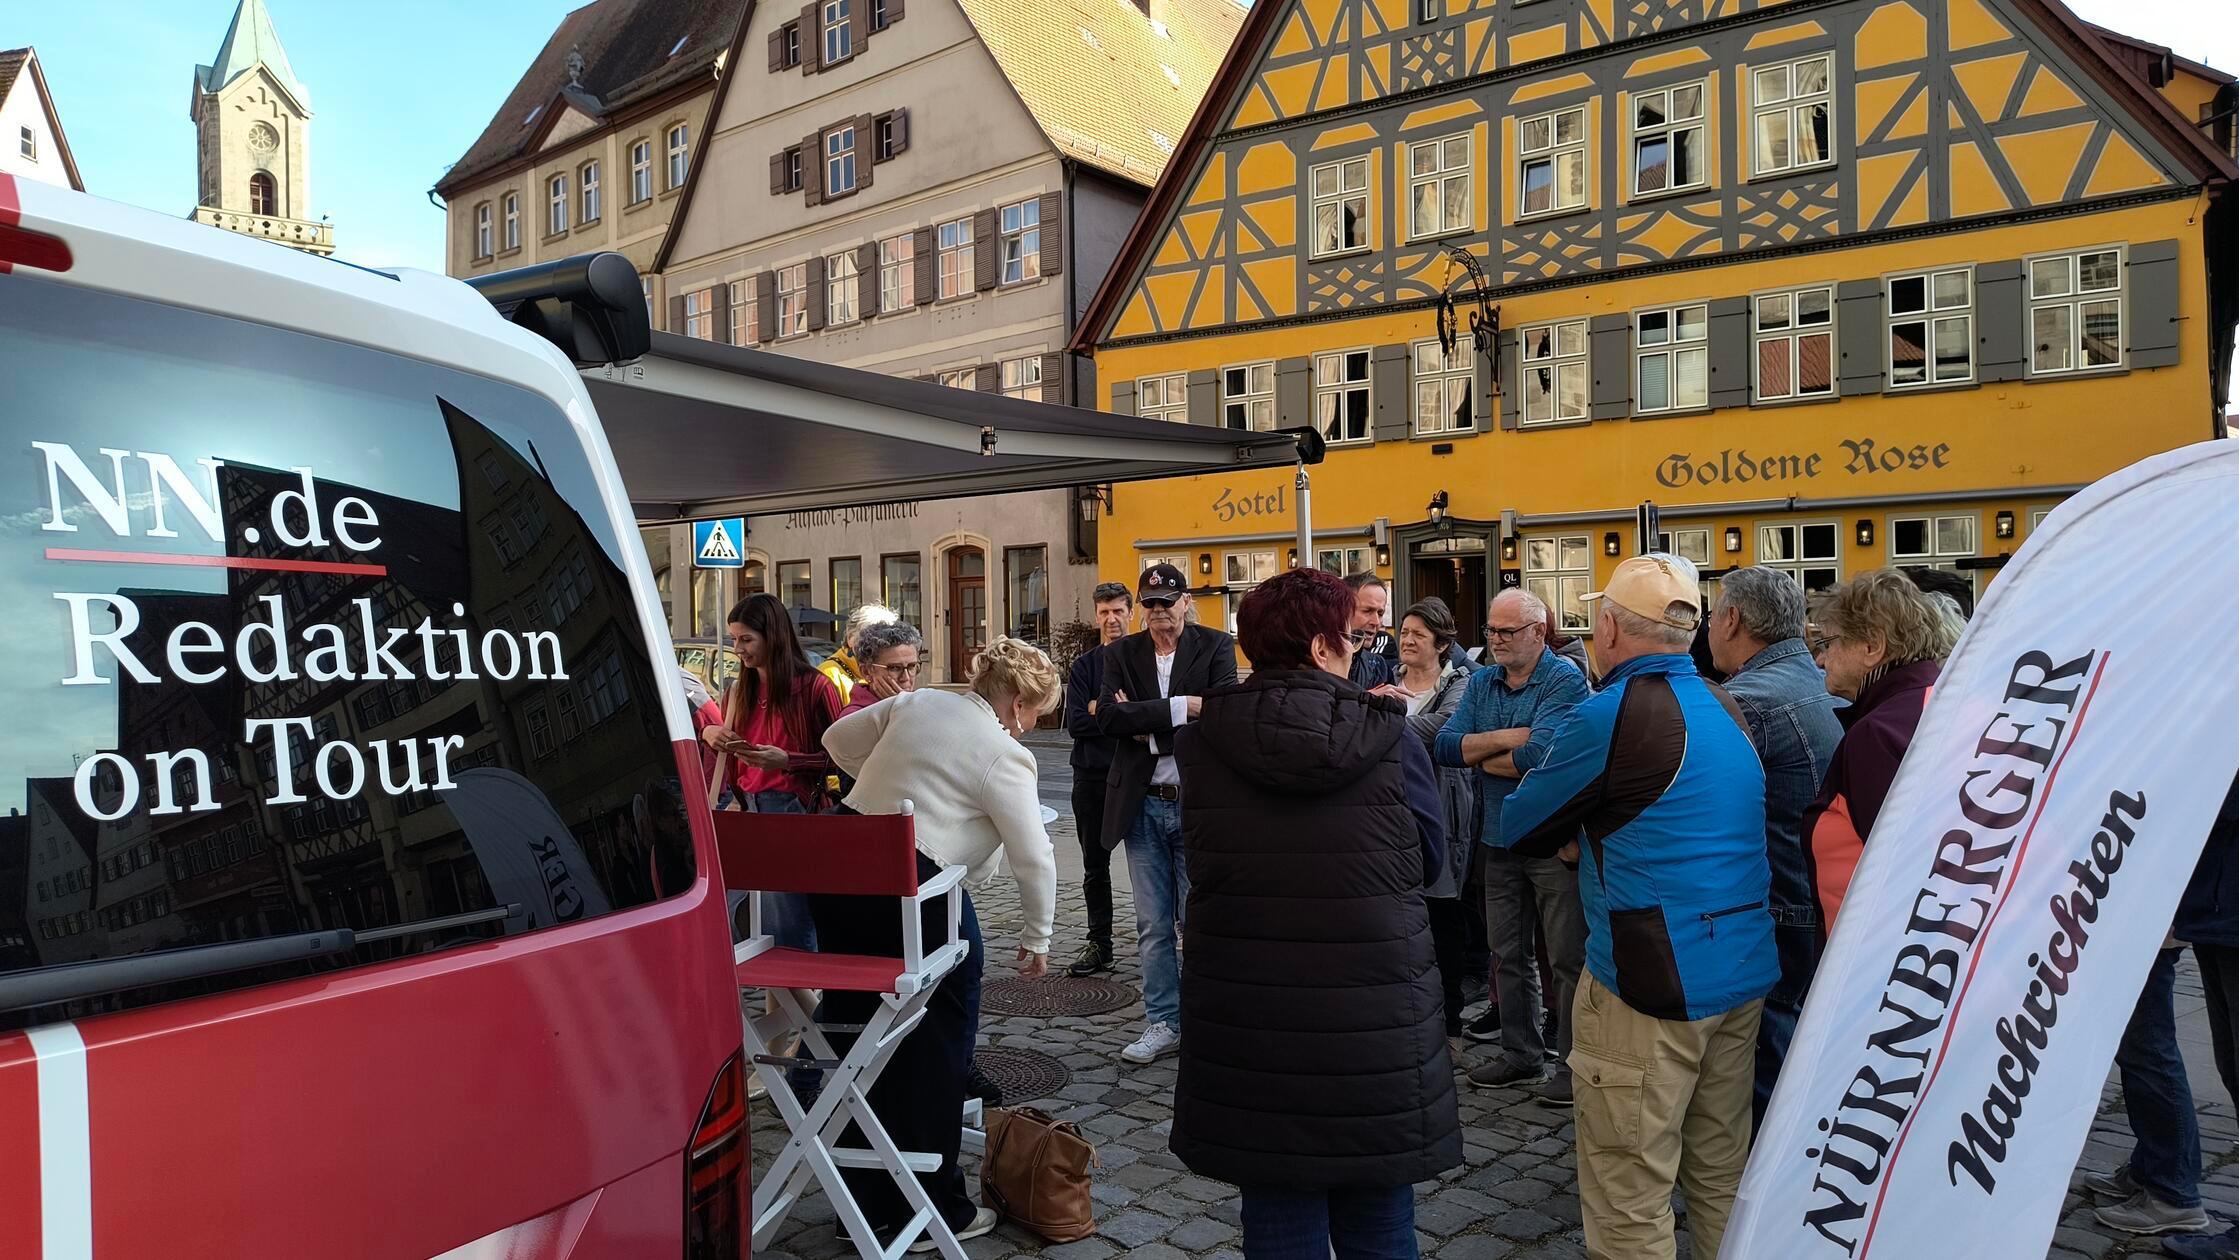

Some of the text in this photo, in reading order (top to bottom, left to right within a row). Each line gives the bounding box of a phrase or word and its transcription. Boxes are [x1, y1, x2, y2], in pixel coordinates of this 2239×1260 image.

[32, 441, 382, 551] NN.de
[1211, 483, 1287, 522] Hotel
[1655, 437, 1951, 489] Goldene Rose
[1503, 573, 1517, 584] QL
[53, 592, 570, 686] Redaktion
[73, 716, 465, 820] on Tour
[1803, 649, 2096, 1258] NÜRNBERGER
[1946, 788, 2146, 1196] Nachrichten
